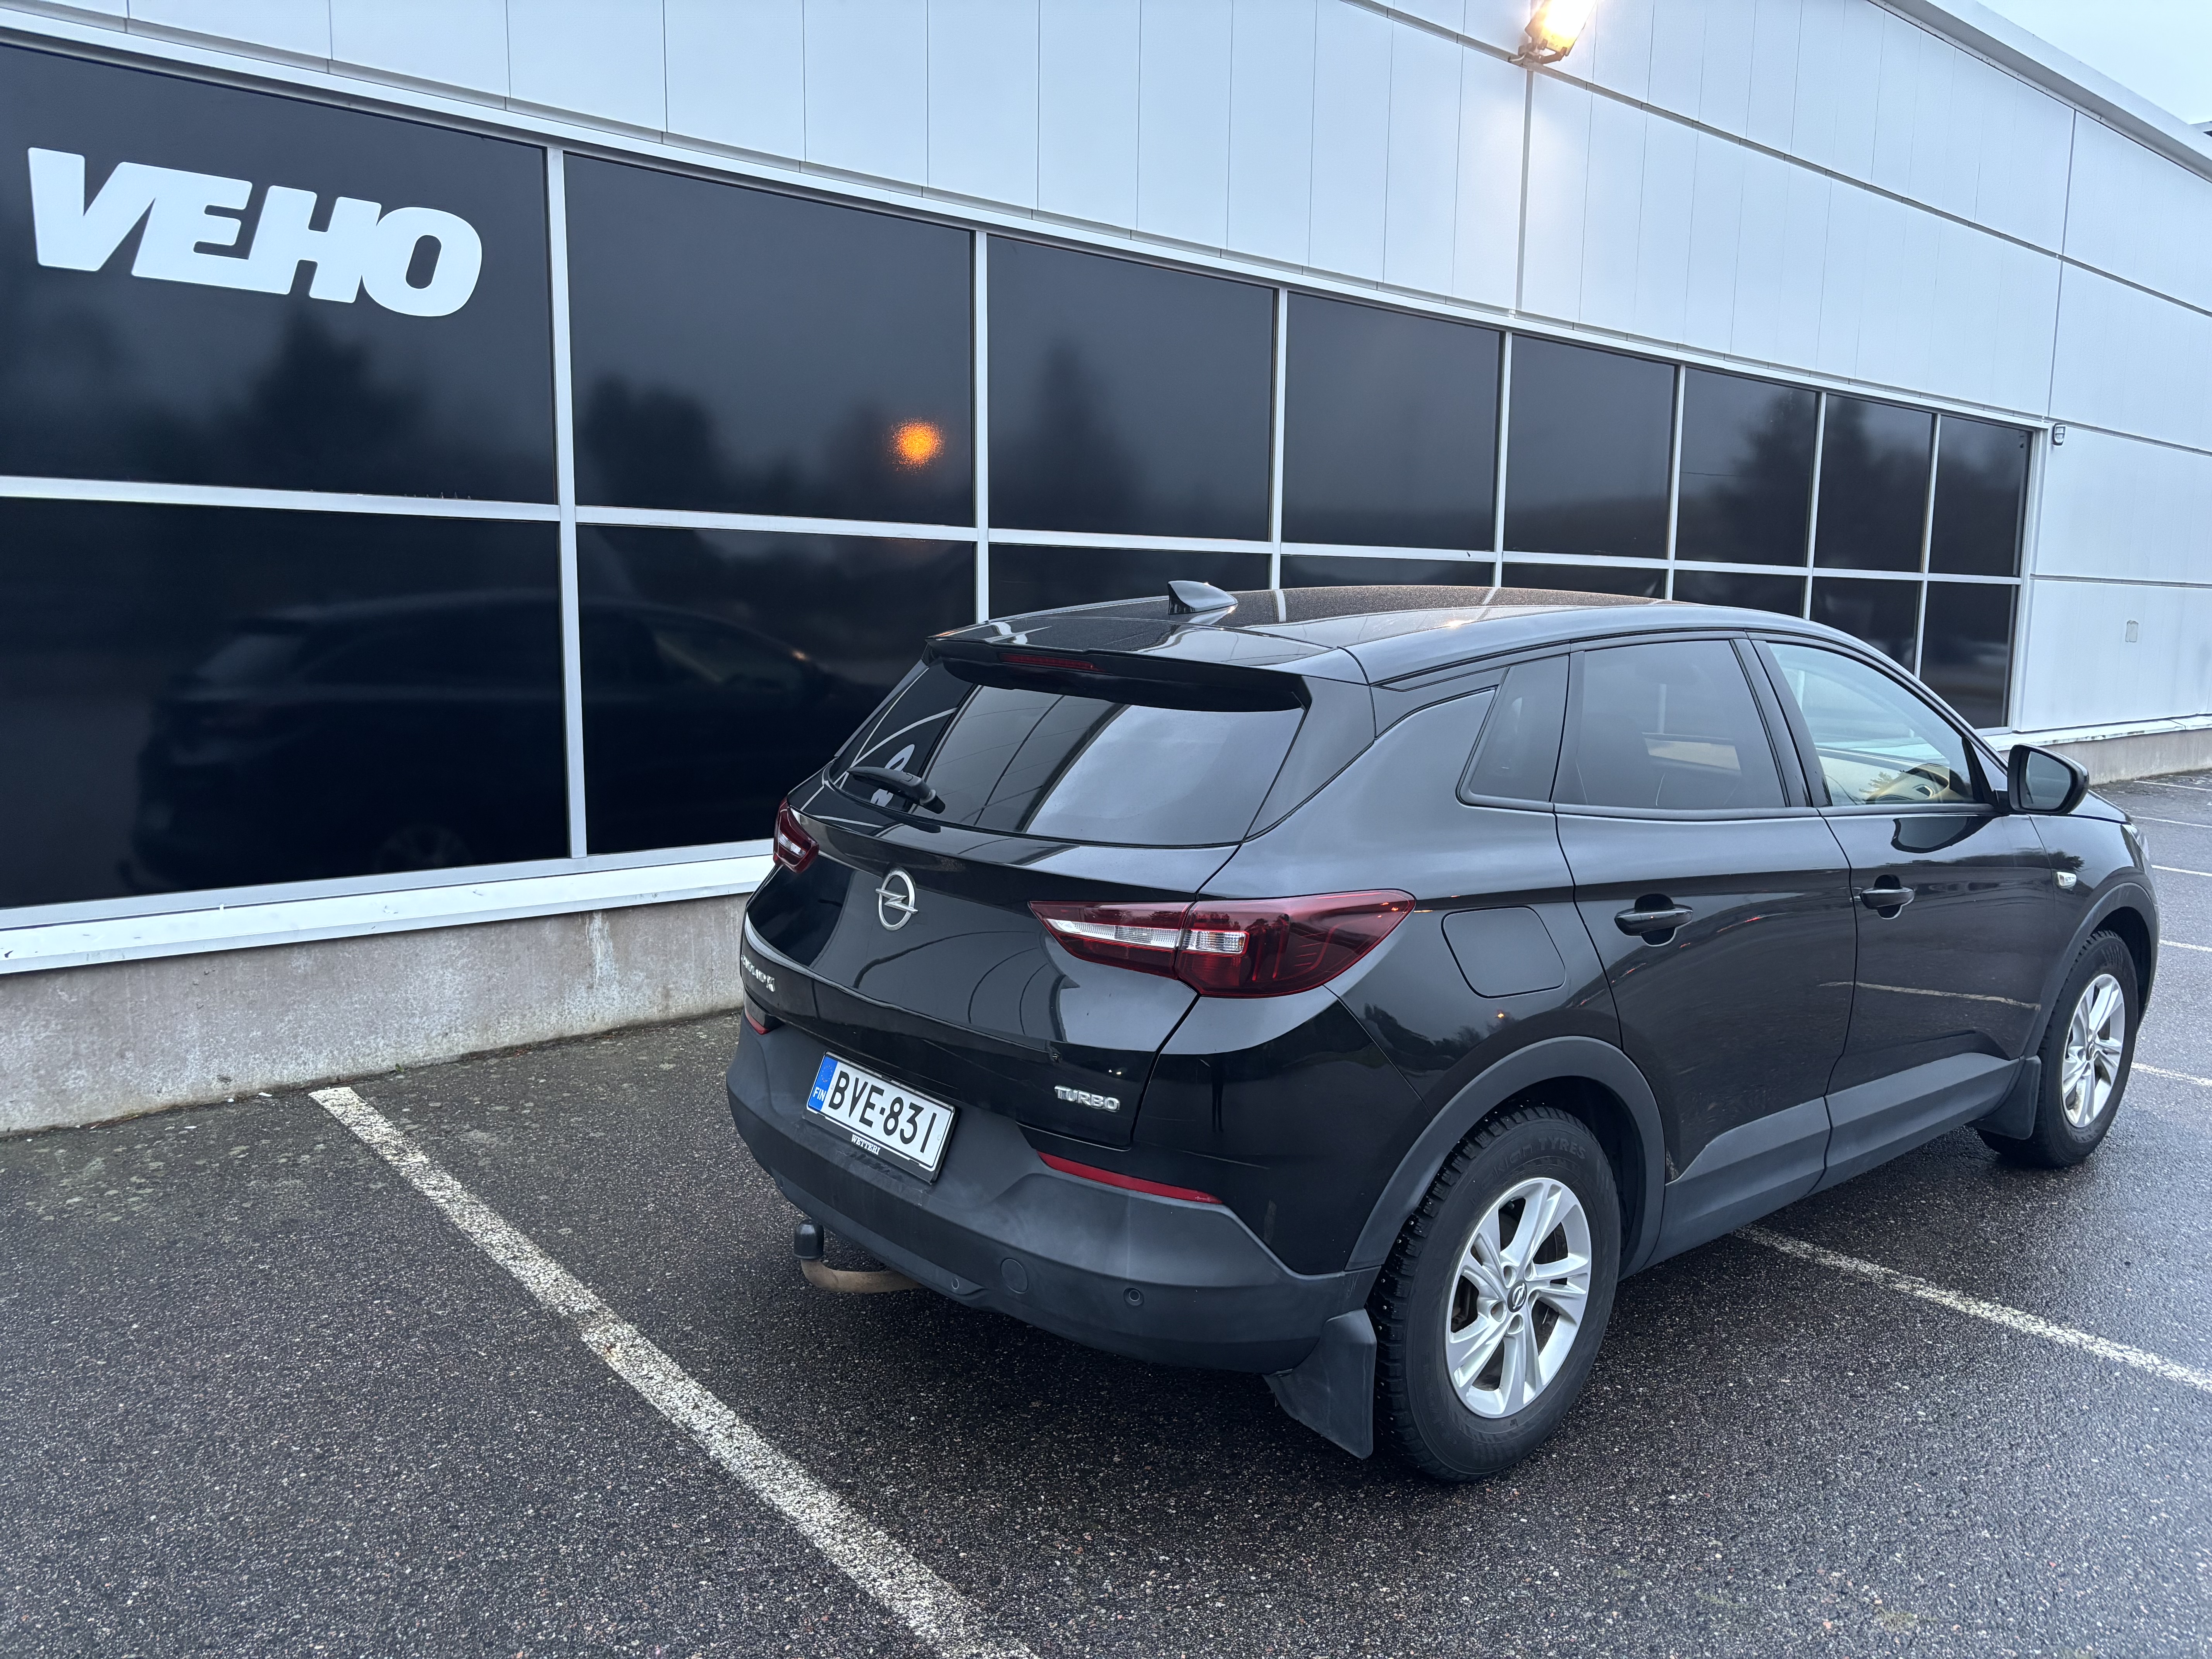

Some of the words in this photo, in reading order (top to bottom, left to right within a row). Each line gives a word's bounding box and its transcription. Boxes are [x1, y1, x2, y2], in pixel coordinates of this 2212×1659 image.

[28, 147, 482, 316] VEHO
[812, 1086, 826, 1102] FIN
[1054, 1085, 1120, 1113] TURBO
[828, 1070, 937, 1153] BVE-831
[851, 1134, 881, 1155] WETTERI
[1538, 1138, 1586, 1159] TYRES
